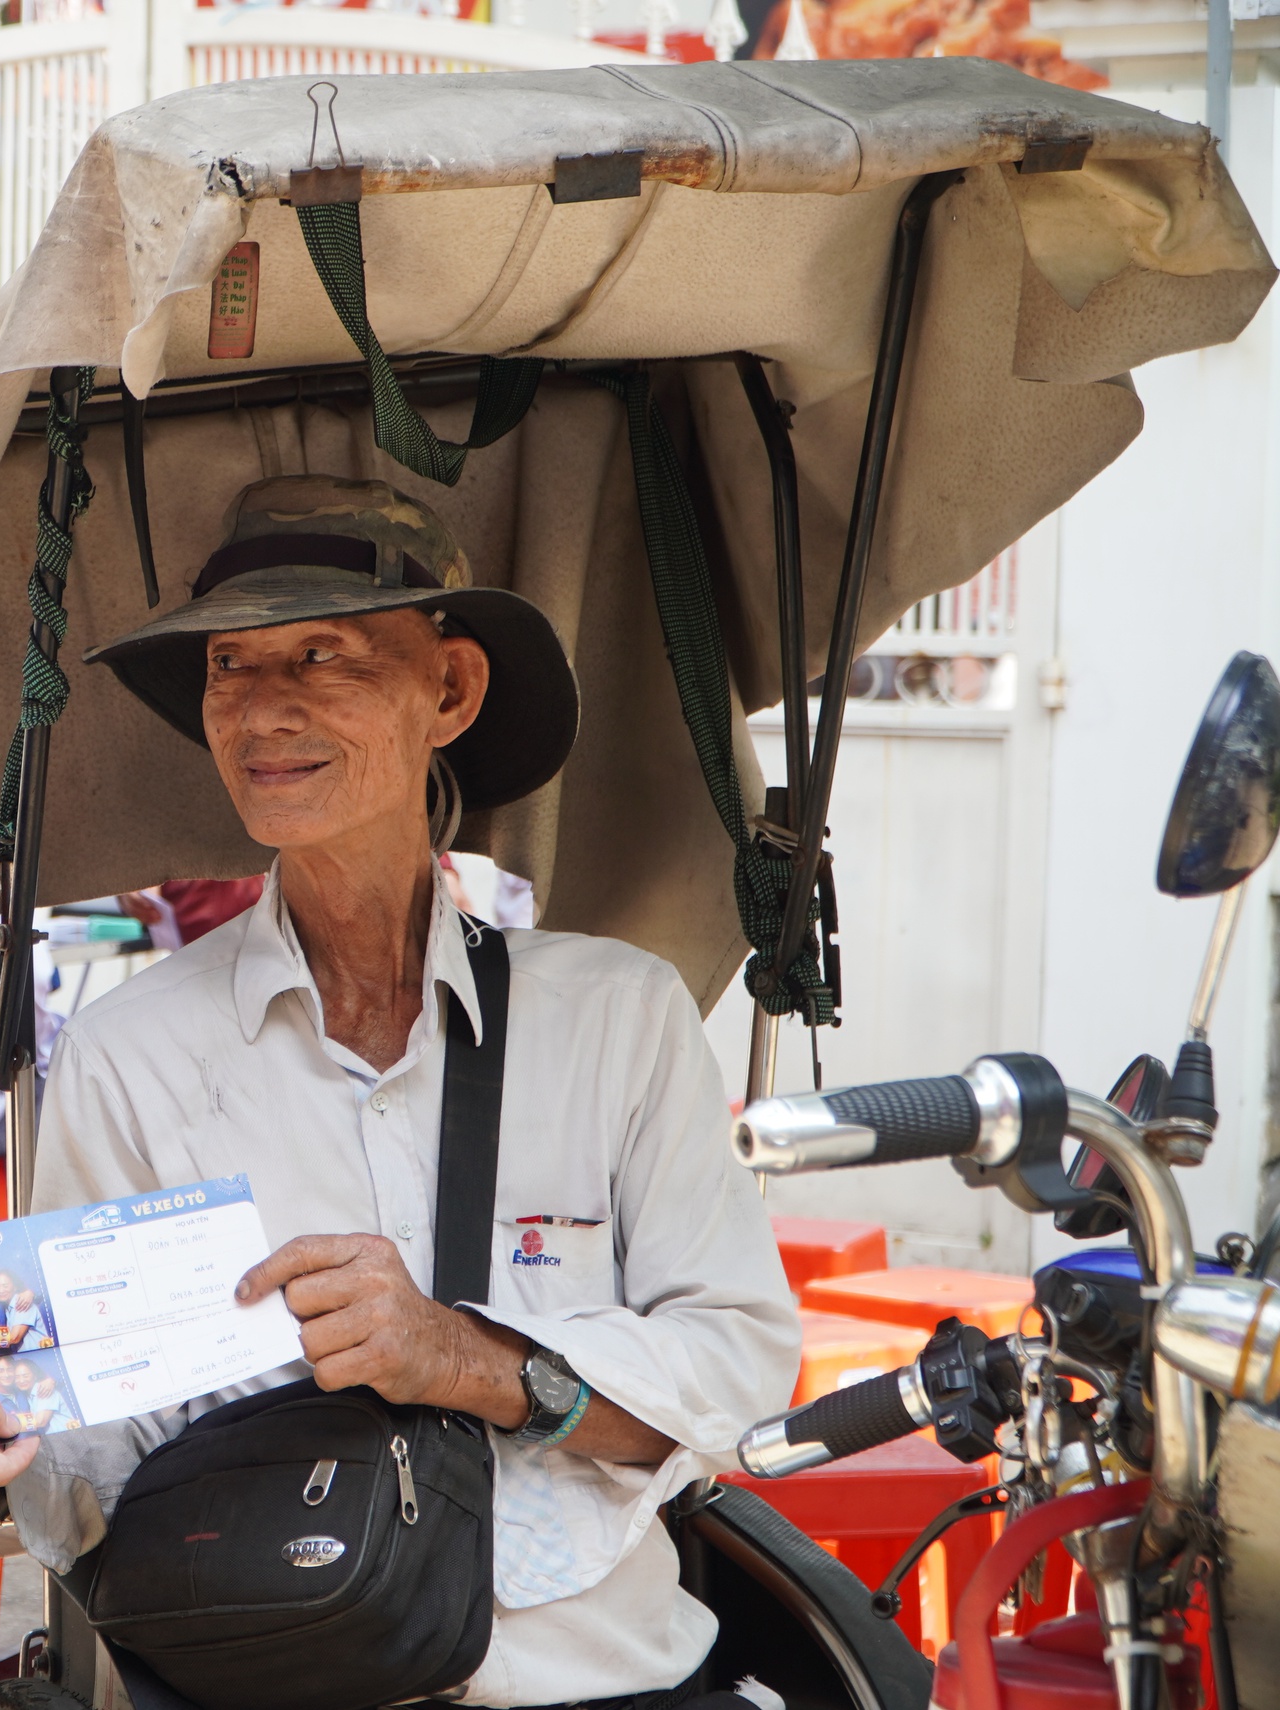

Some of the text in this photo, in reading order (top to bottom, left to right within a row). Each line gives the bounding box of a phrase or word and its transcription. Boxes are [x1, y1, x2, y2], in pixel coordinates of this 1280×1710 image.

[220, 281, 229, 290] 大
[131, 1189, 206, 1217] VÉ XE Ô TÔ
